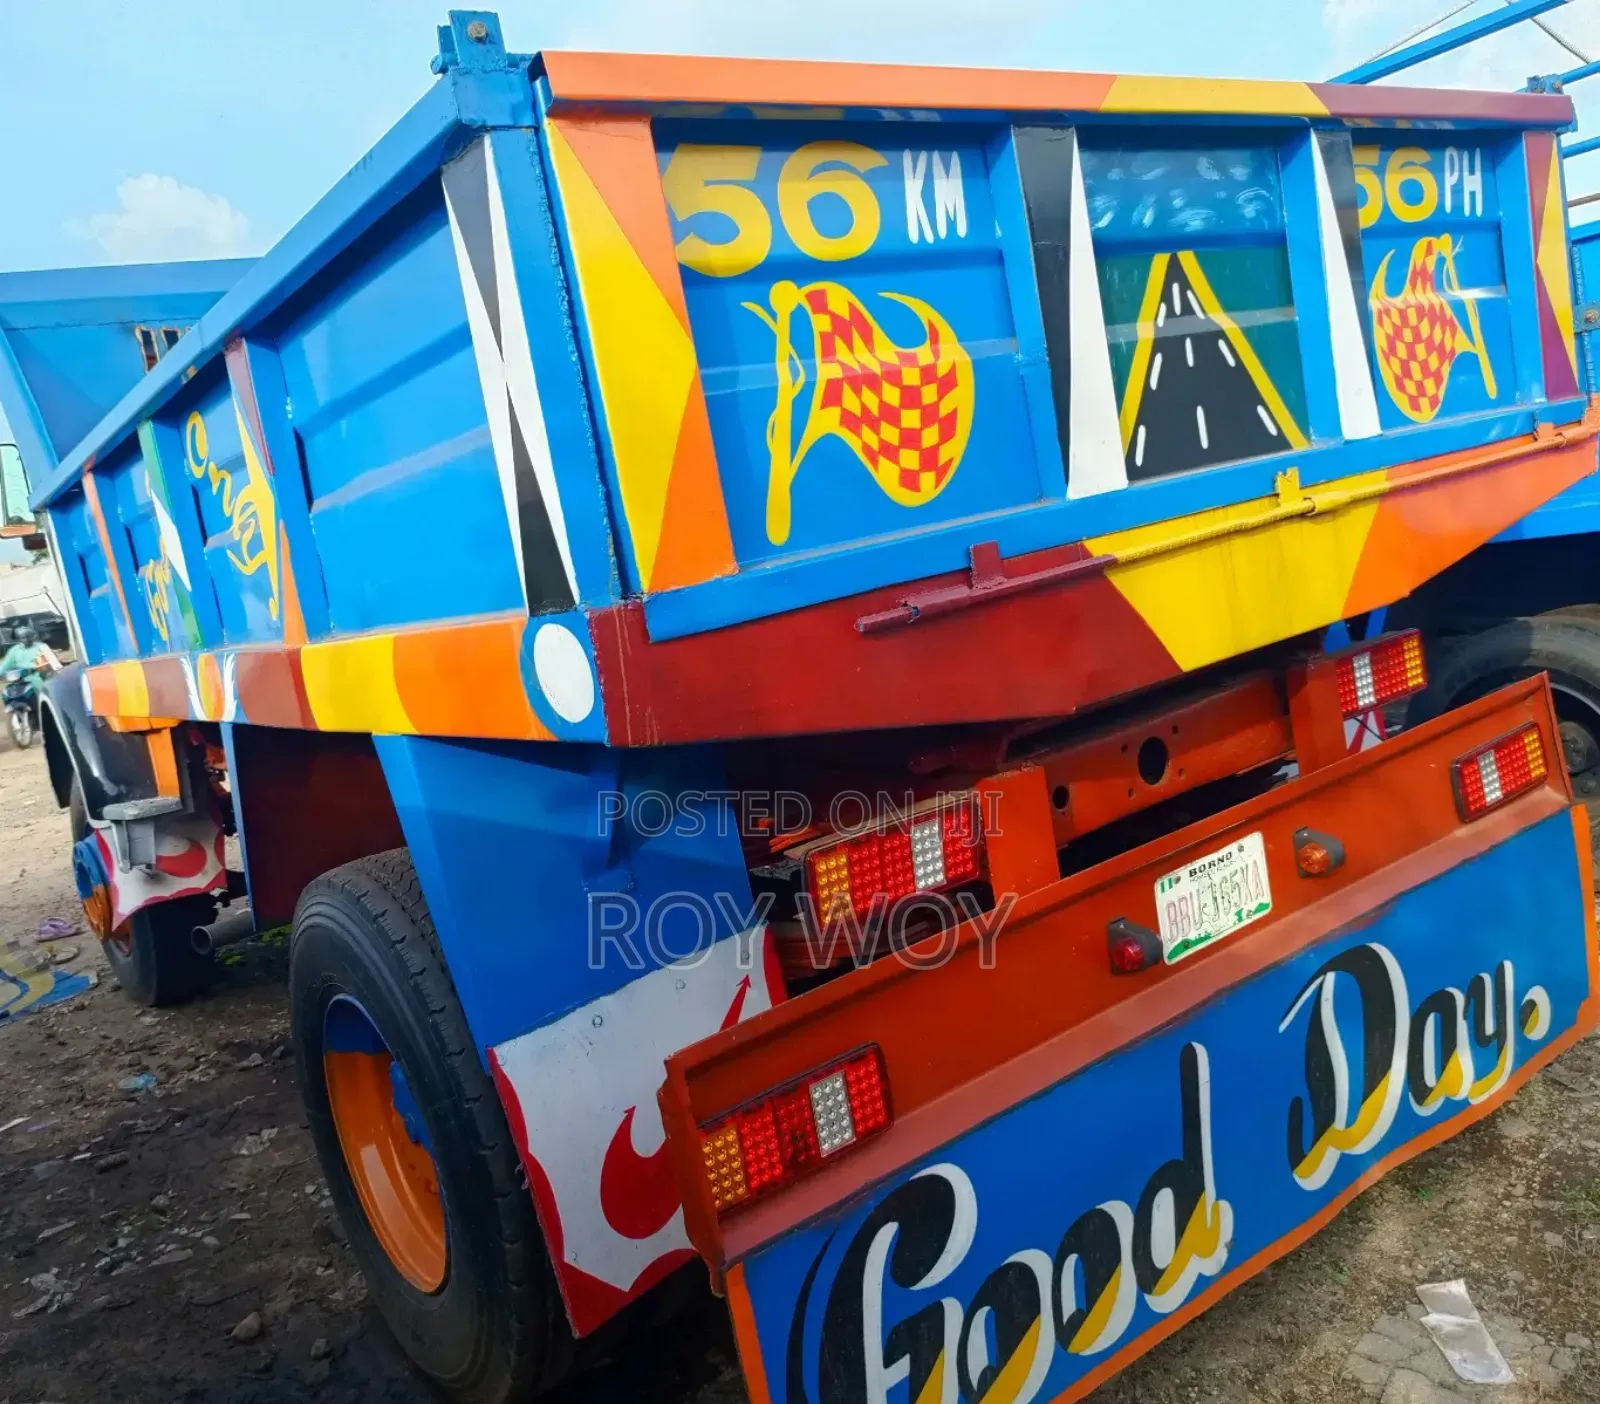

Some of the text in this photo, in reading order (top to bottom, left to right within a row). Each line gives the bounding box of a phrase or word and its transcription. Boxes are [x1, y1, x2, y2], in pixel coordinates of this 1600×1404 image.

[661, 140, 967, 277] 56 KM
[1443, 146, 1483, 217] PH
[1188, 851, 1233, 878] BORNO
[786, 1041, 1234, 1404] Good
